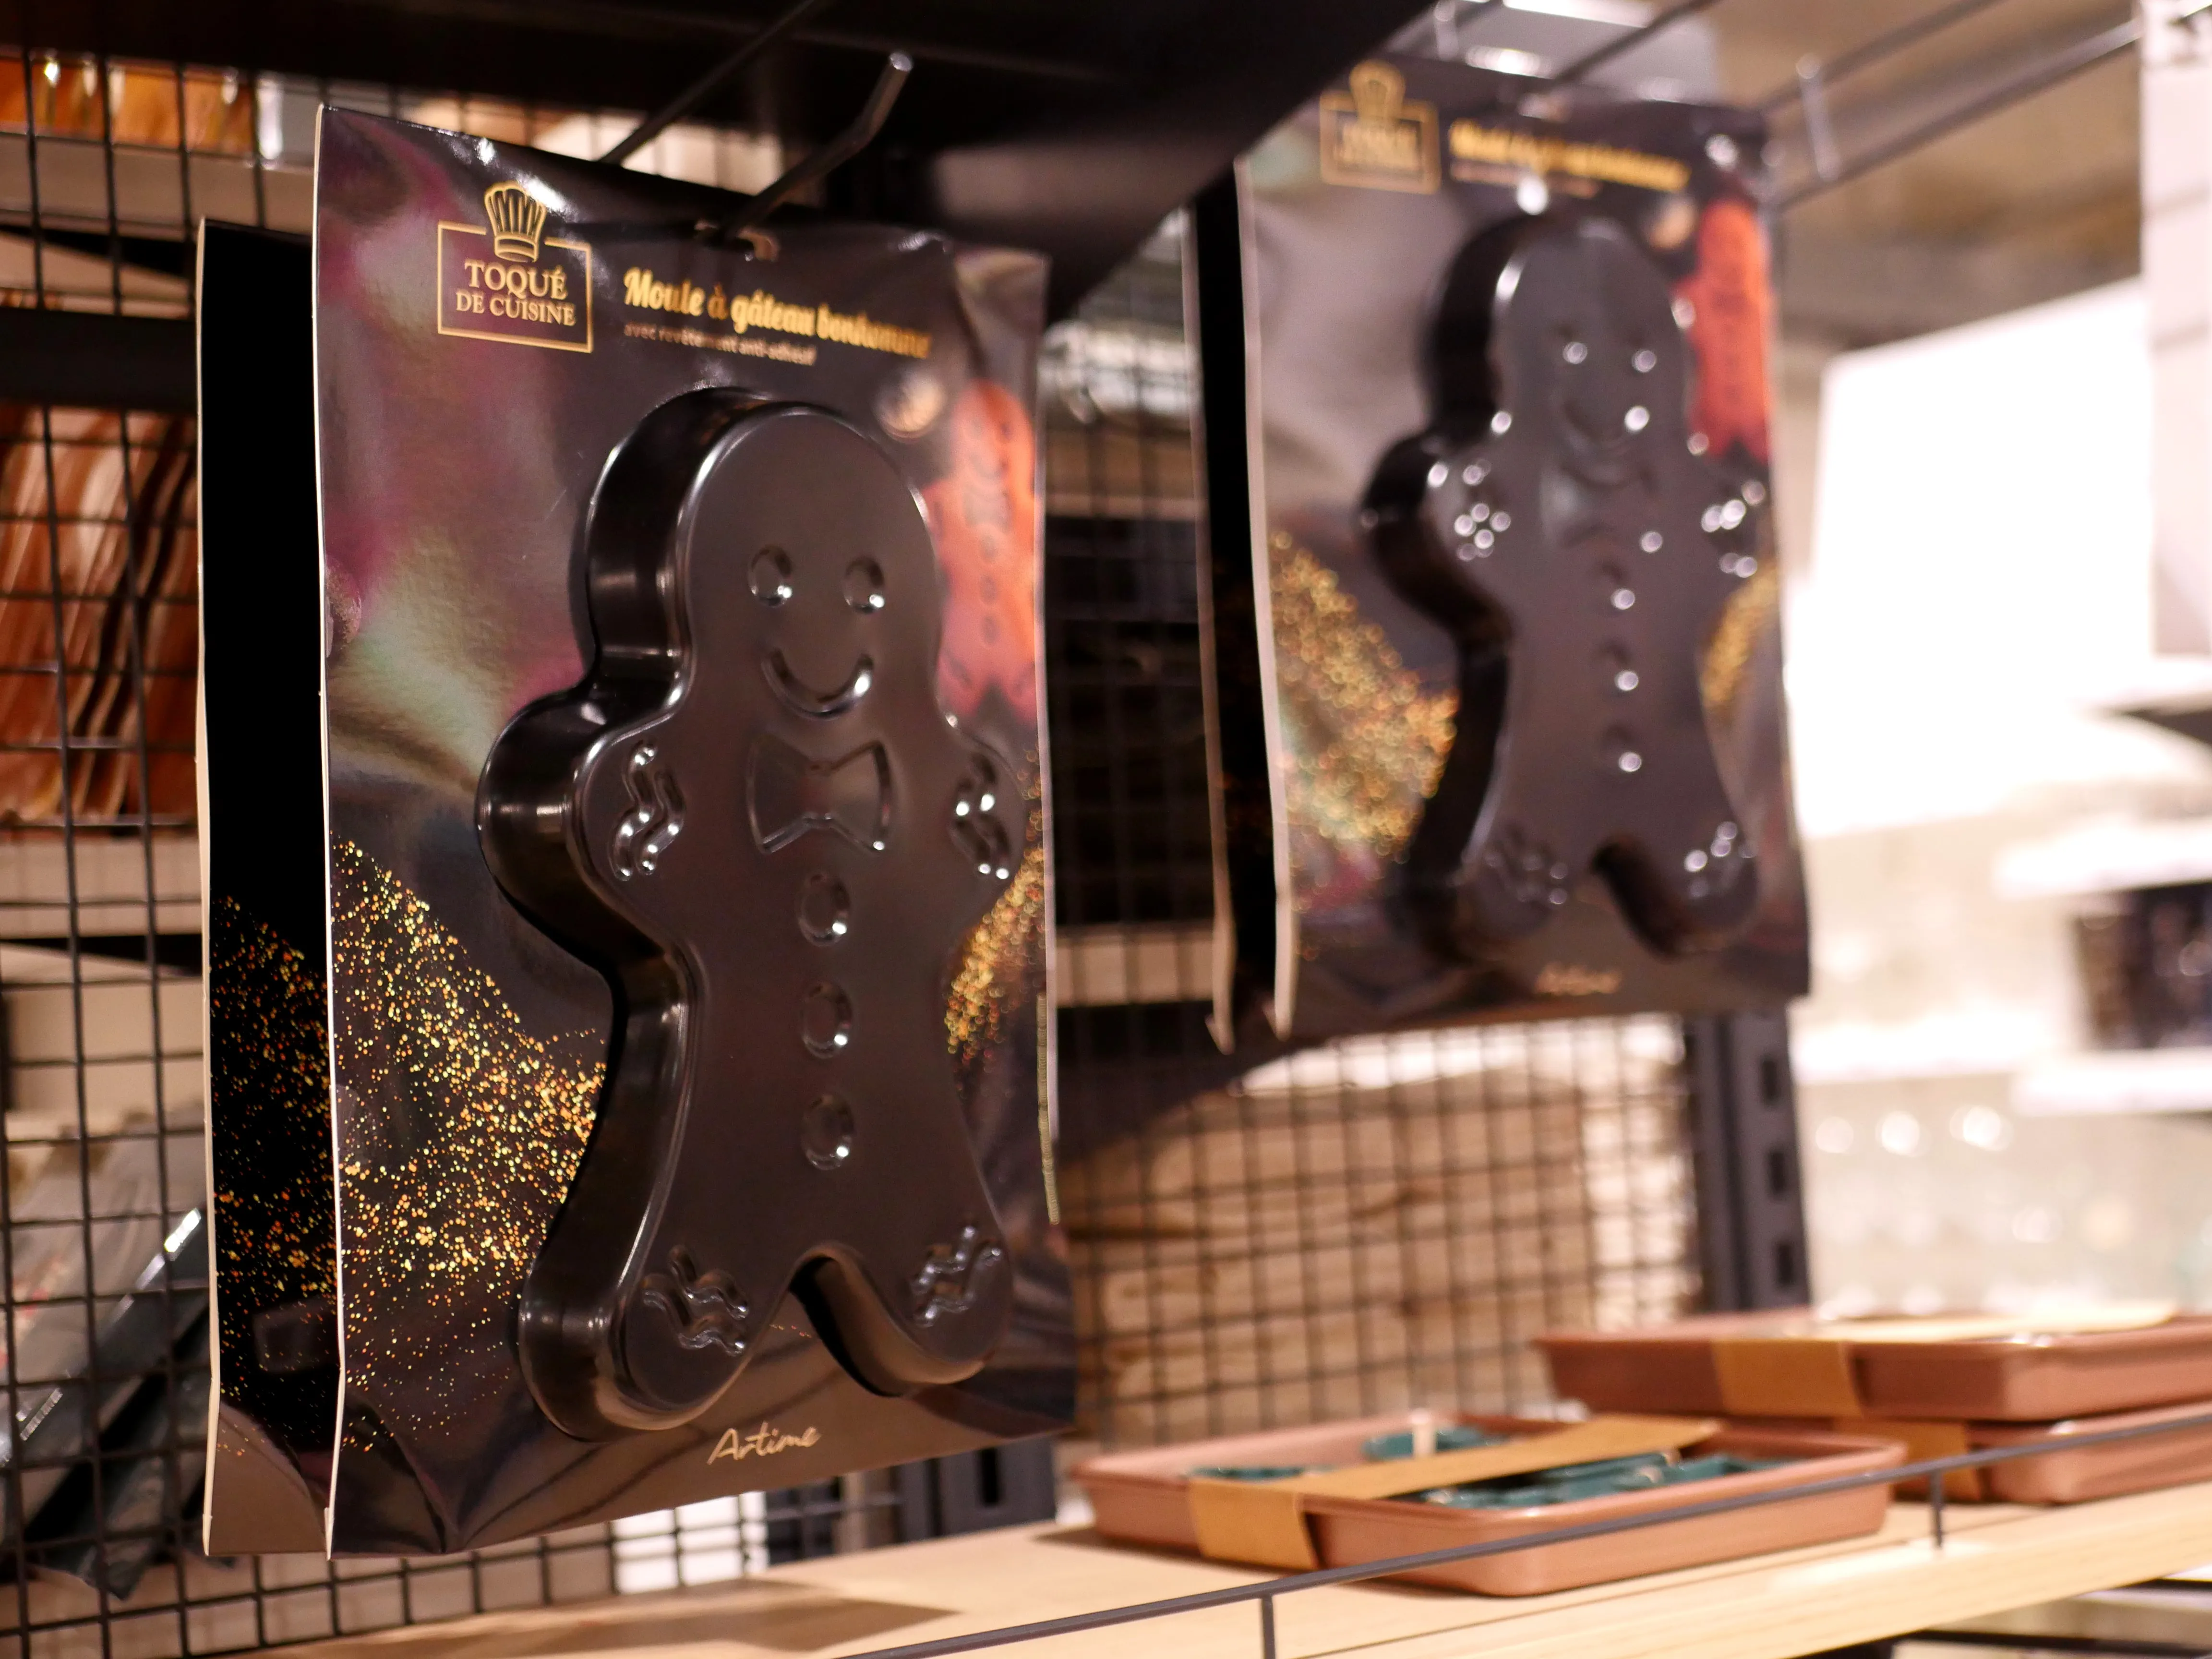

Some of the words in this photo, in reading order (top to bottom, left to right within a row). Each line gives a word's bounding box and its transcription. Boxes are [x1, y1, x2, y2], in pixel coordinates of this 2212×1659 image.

[464, 258, 568, 301] TOQUÉ
[624, 266, 705, 317] Moule
[708, 282, 728, 321] à
[730, 289, 816, 334] gâteau
[456, 289, 485, 314] DE
[489, 293, 576, 327] CUISINE
